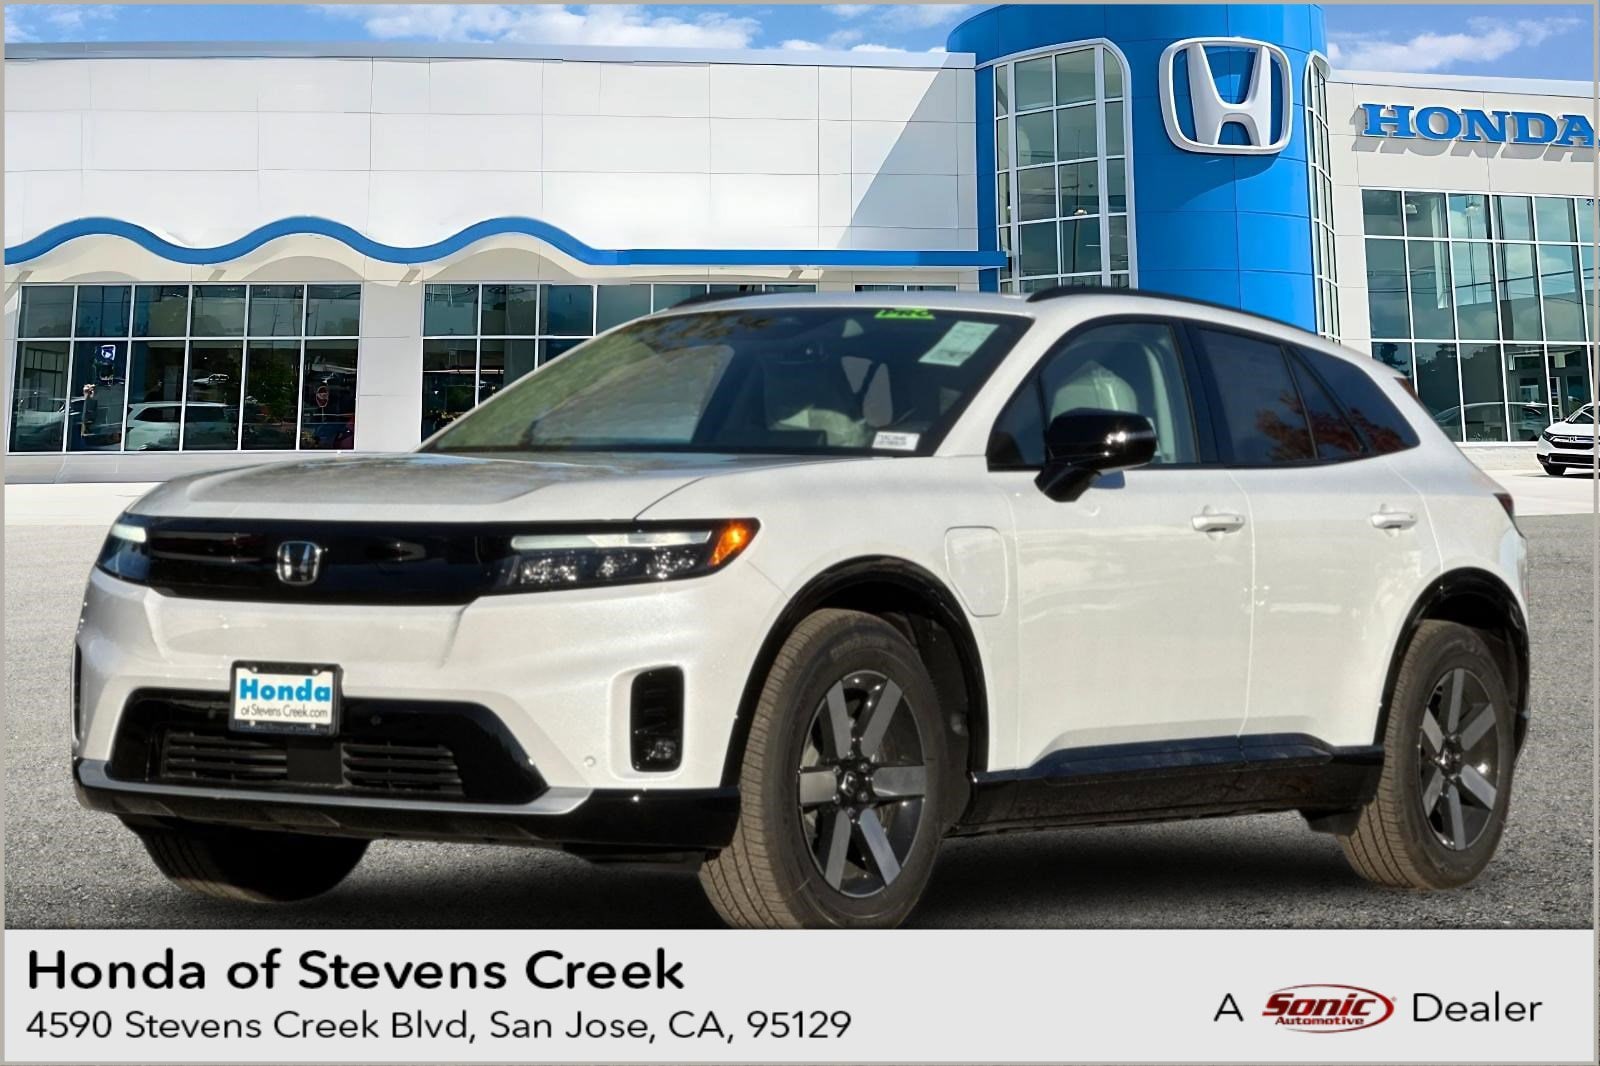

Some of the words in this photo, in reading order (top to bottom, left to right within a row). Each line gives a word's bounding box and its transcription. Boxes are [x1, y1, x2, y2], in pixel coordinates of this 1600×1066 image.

[1361, 103, 1594, 147] HONDA
[240, 678, 331, 702] Honda
[240, 705, 251, 716] of
[251, 704, 282, 717] Stevens
[282, 704, 328, 718] Creek.com
